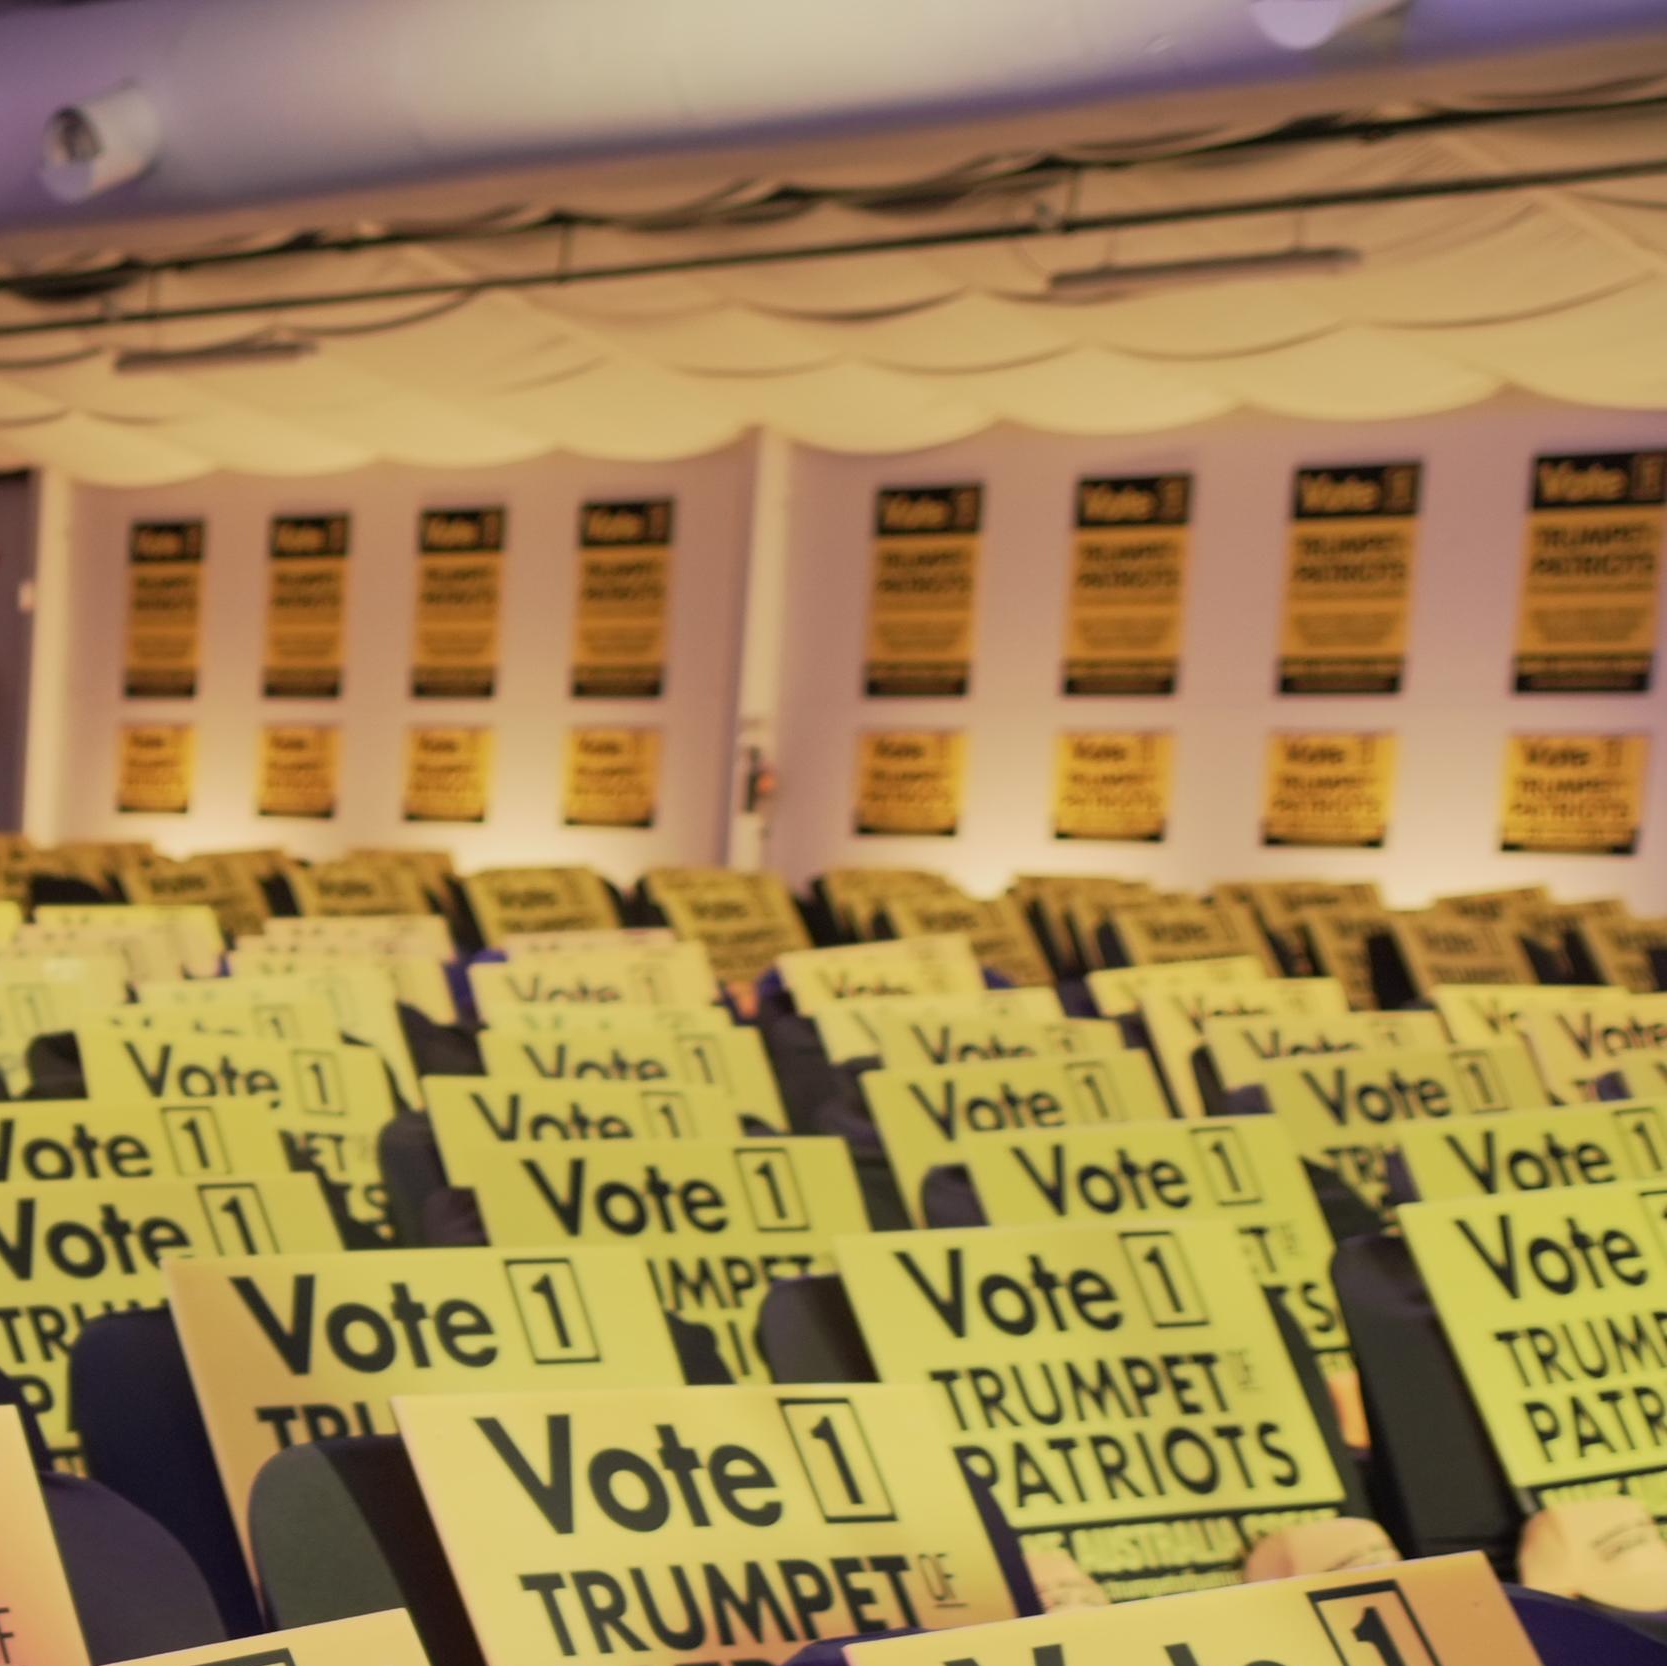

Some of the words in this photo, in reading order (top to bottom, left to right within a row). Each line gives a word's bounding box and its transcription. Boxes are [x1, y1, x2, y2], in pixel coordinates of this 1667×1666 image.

[124, 1041, 279, 1098] Vote
[1301, 1068, 1453, 1127] Vote
[909, 1080, 1065, 1141] Vote
[524, 1158, 727, 1236] Vote
[1012, 1144, 1192, 1217] Vote
[1445, 1130, 1611, 1195] Vote
[895, 1248, 1124, 1340] Vote
[1454, 1215, 1648, 1299] Vote
[229, 1273, 498, 1375] Vote
[930, 1352, 1230, 1432] TRUMPET
[474, 1414, 784, 1535] Vote
[952, 1422, 1301, 1509] PATRIOTS
[519, 1555, 910, 1656] TRUMPET
[919, 1553, 955, 1598] OF
